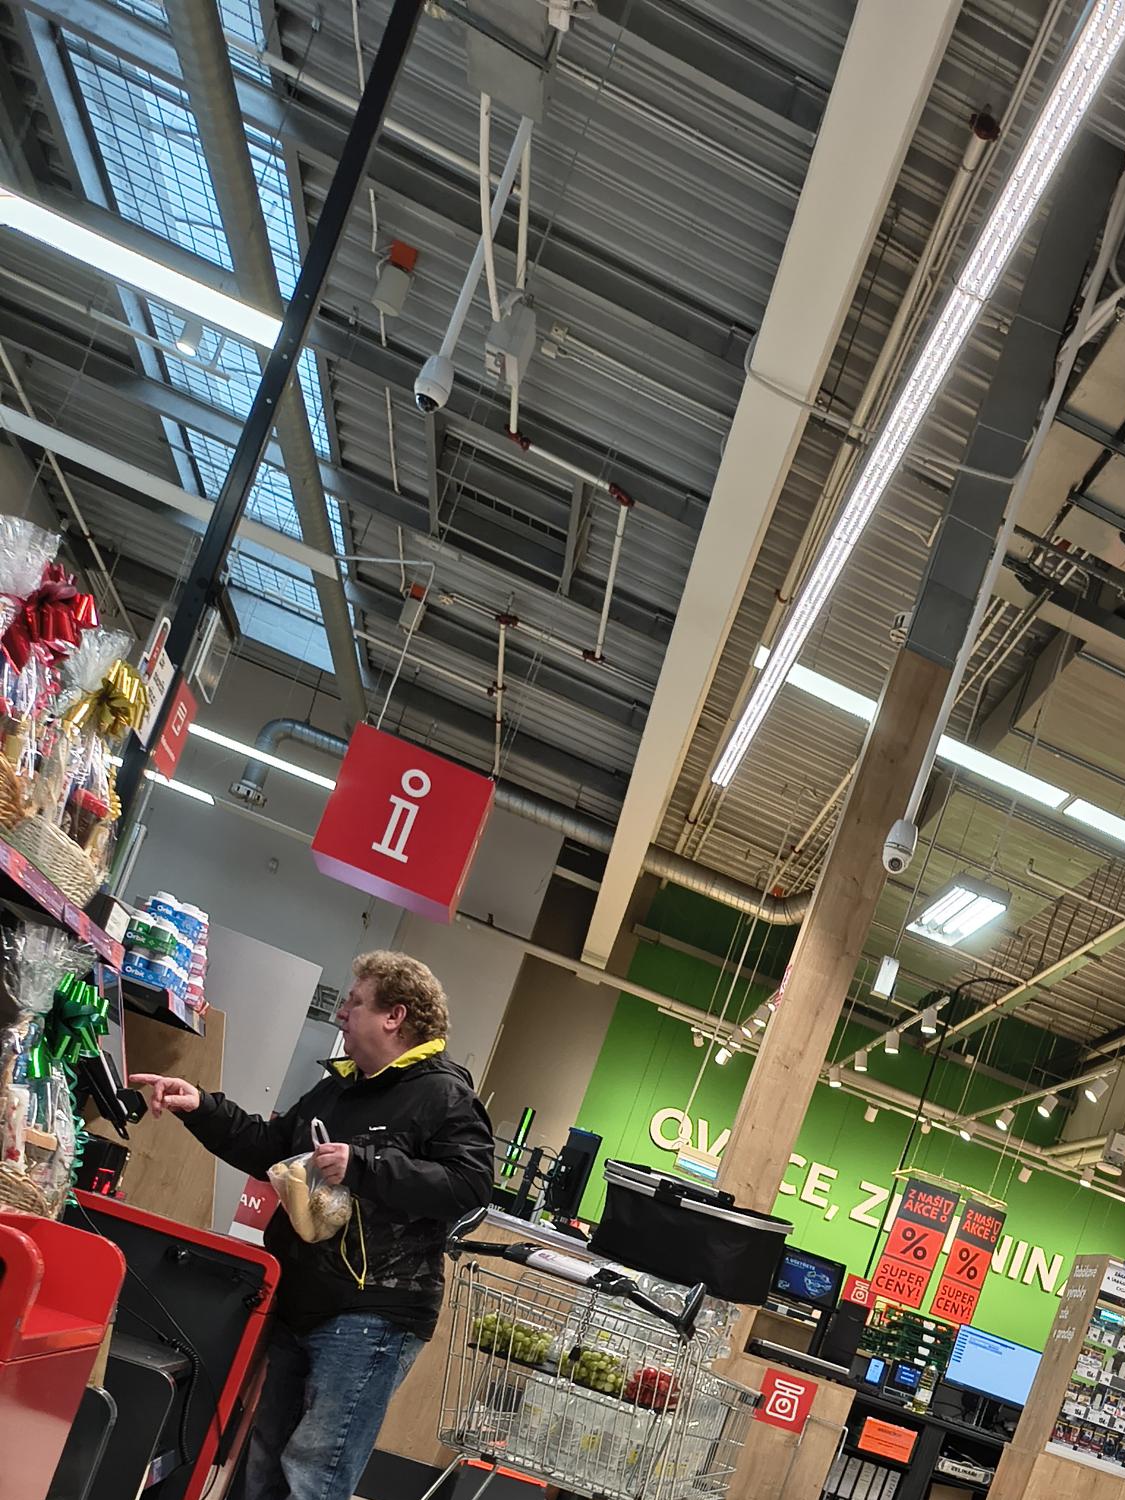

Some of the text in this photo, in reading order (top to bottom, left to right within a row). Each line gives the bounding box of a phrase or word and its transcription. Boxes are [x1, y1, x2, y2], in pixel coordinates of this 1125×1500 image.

[126, 931, 145, 943] Orbit
[125, 965, 145, 978] Orbit
[908, 1188, 915, 1199] Z
[966, 1209, 973, 1219] Z
[881, 1264, 925, 1286] SUPER
[876, 1276, 921, 1300] CENY!
[941, 1285, 975, 1306] SUPER
[936, 1297, 972, 1320] CENY!
